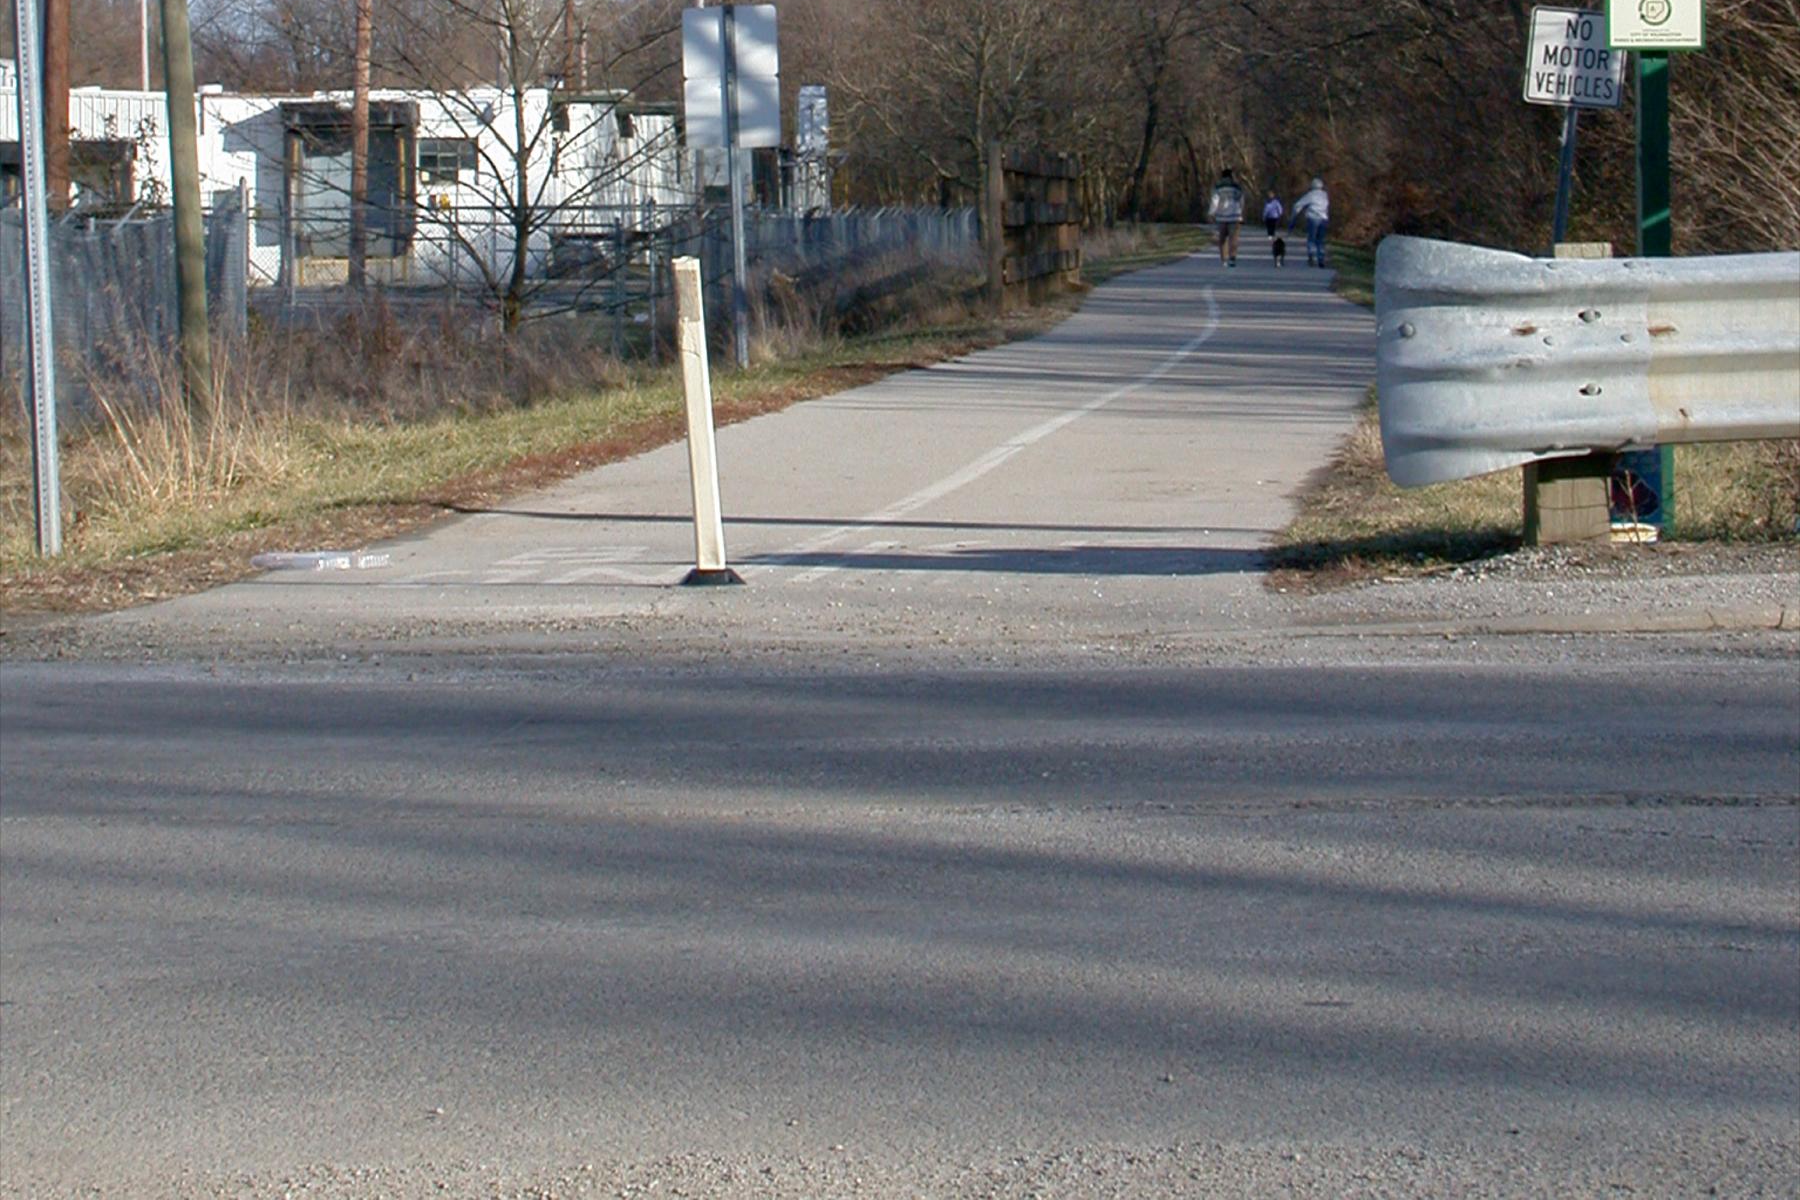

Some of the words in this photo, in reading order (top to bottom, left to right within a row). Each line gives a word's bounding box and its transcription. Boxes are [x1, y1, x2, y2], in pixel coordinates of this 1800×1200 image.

[1566, 18, 1593, 41] NO
[1542, 44, 1610, 71] MOTOR
[1535, 71, 1614, 100] VEHICLES
